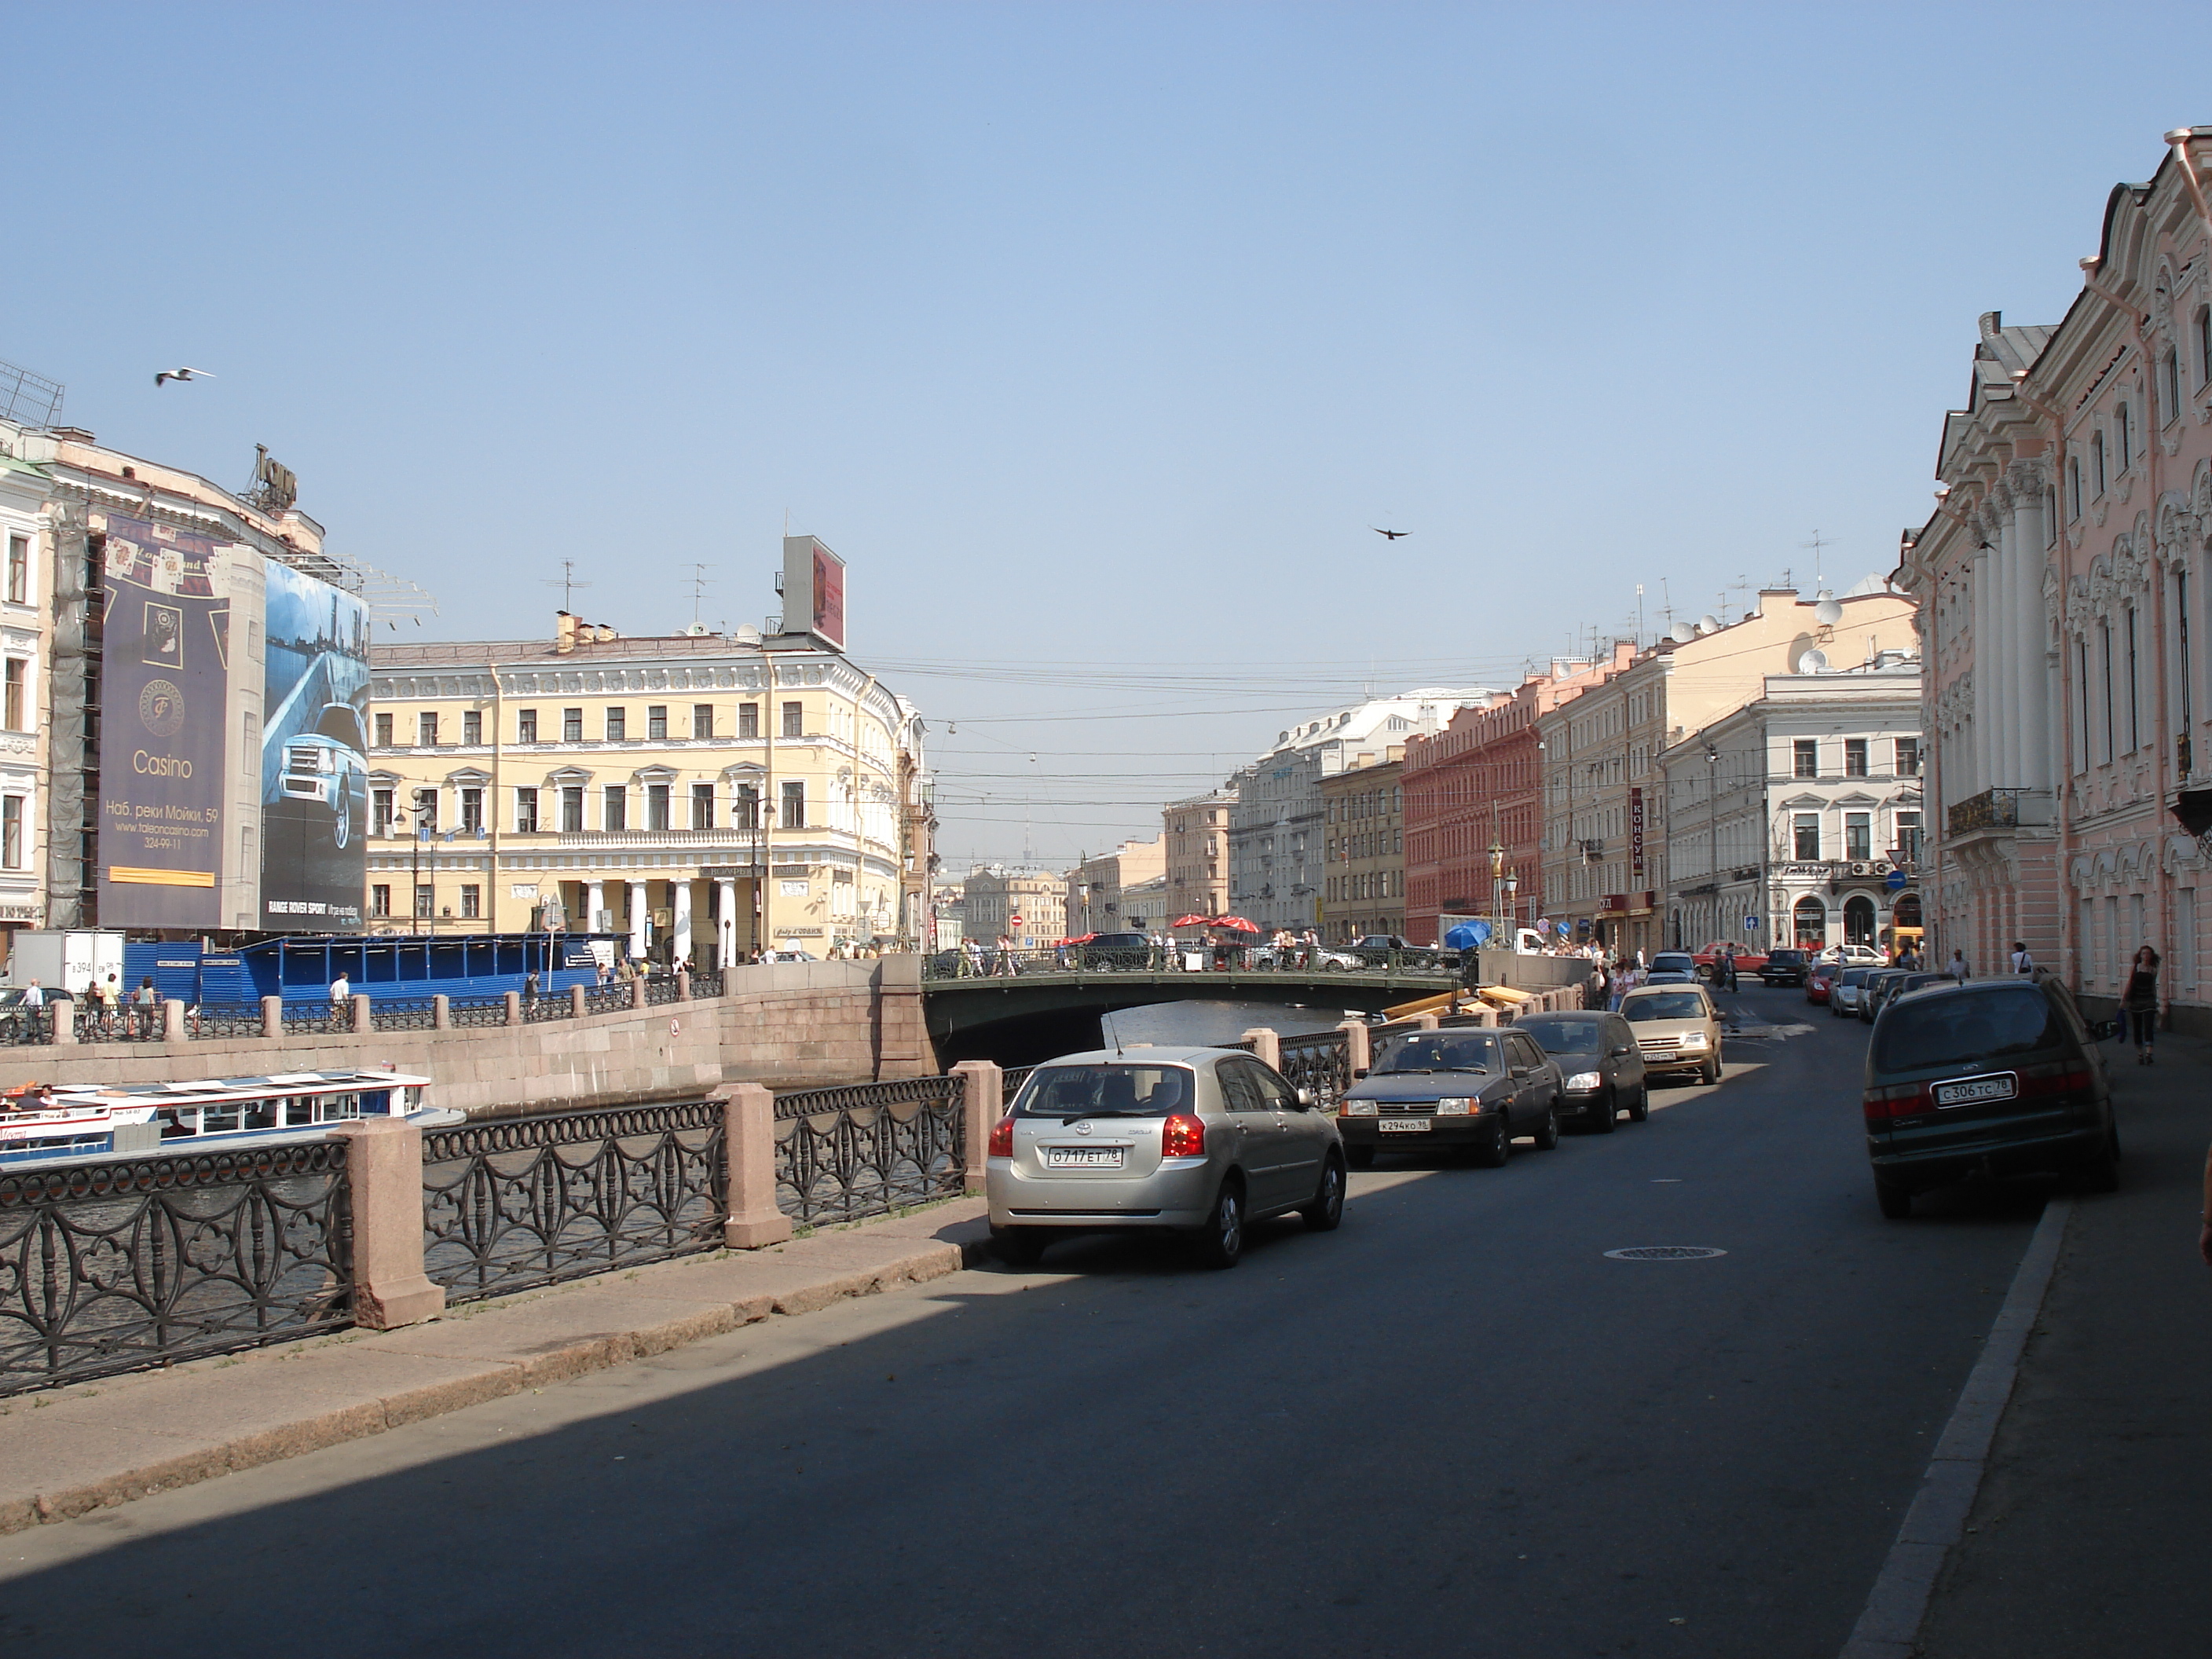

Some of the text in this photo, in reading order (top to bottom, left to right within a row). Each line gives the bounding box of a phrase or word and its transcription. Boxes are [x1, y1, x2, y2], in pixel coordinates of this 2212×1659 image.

[133, 749, 193, 779] Casino
[105, 800, 218, 823] Наб. реки Мойки, 59
[115, 822, 209, 837] www.taleoncasino.com
[1633, 805, 1643, 864] КОНСУЛ
[145, 837, 181, 850] 324-99-11
[269, 900, 288, 914] RANGE
[289, 901, 307, 914] ROVER
[308, 902, 327, 915] SPORT
[1105, 1149, 1118, 1159] 78
